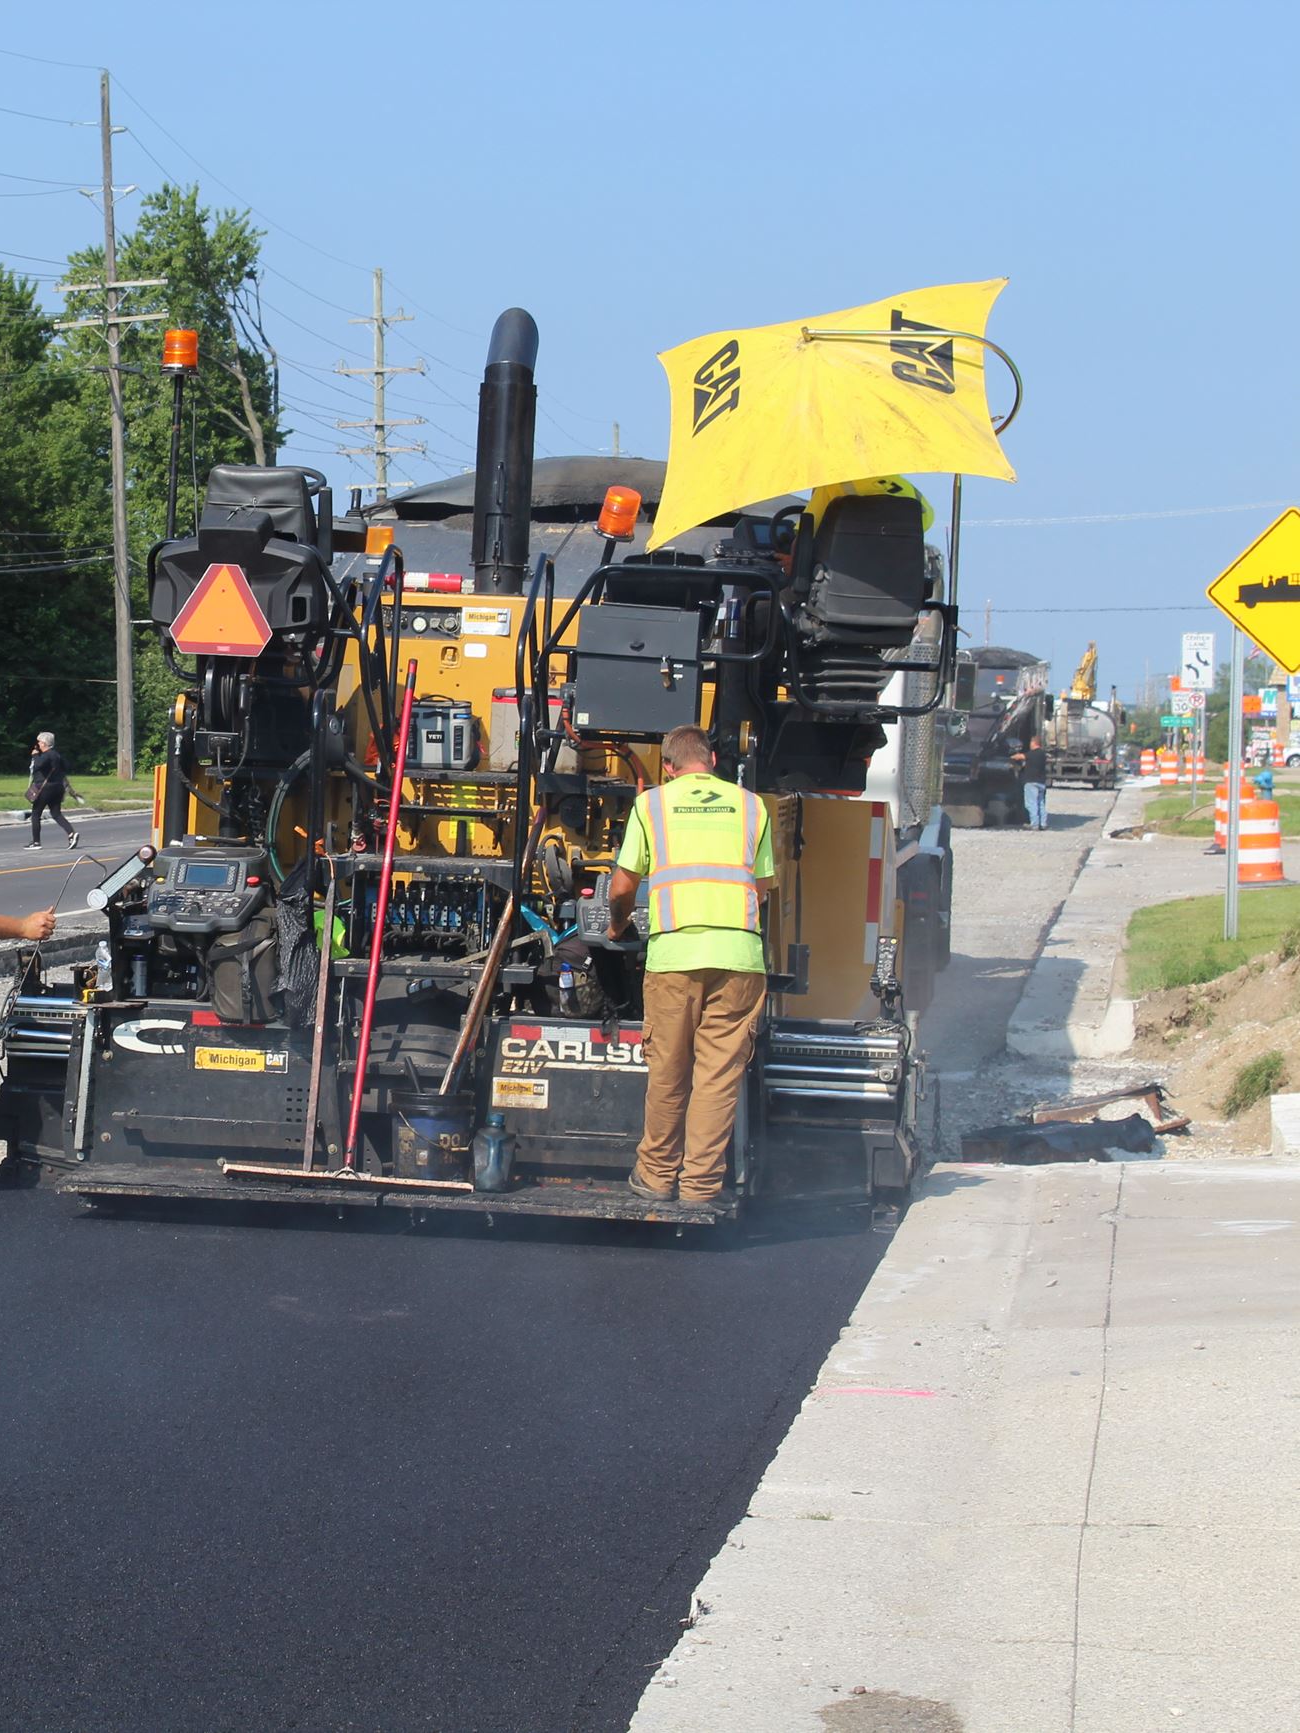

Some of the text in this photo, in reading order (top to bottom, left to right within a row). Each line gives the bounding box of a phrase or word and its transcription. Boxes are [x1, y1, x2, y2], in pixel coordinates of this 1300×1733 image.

[890, 309, 956, 394] CAT
[692, 339, 741, 438] CAT
[467, 612, 496, 621] Michigan
[209, 1053, 286, 1067] Michigan CAT
